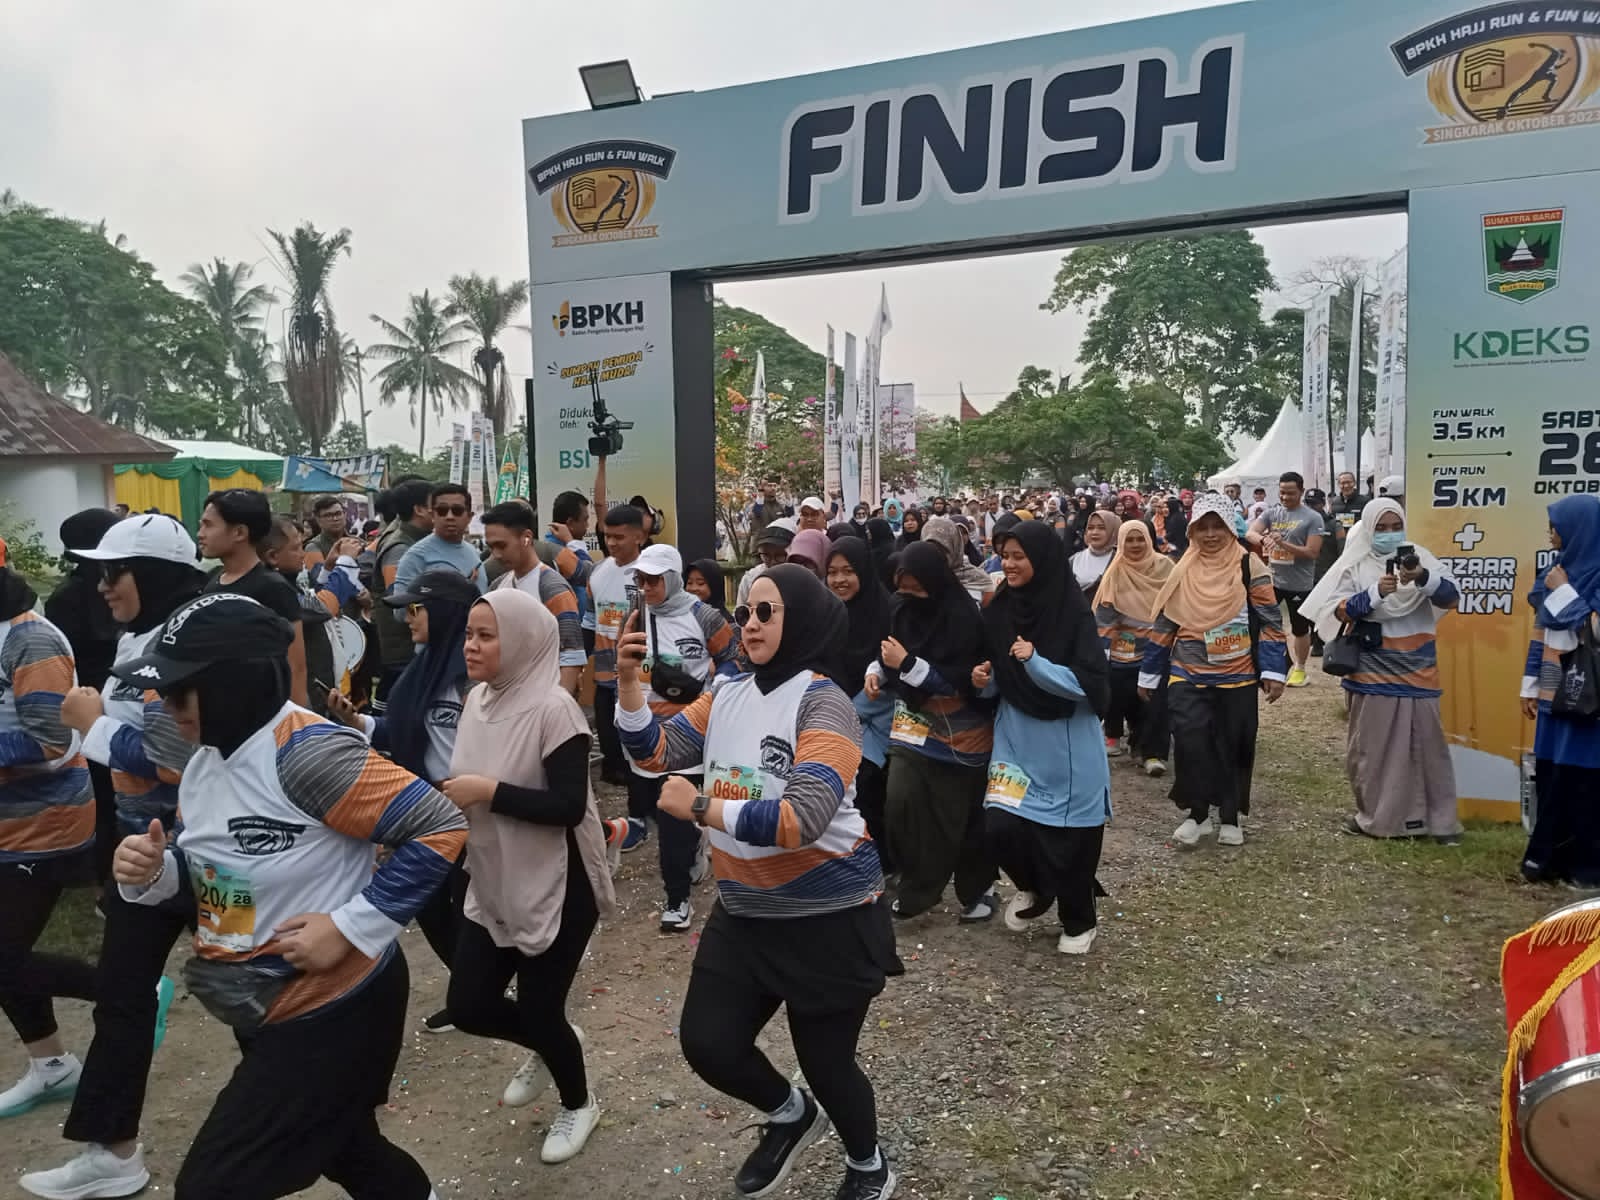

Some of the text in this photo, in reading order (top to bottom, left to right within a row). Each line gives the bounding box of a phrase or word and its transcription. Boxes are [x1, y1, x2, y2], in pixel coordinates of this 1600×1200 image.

[1405, 33, 1447, 60] BPKH
[1450, 20, 1485, 41] HAJJ
[1490, 12, 1524, 30] RUN
[1528, 11, 1540, 23] &
[1545, 10, 1578, 22] FUN
[785, 44, 1236, 218] FINISH
[1433, 119, 1504, 141] SINGKARAK
[1508, 113, 1565, 132] OKTOBER
[536, 150, 666, 182] BPKH HAJJ RUN & FUN WALK
[1532, 211, 1561, 221] BARAT
[571, 301, 644, 329] BPKH
[1454, 325, 1590, 360] KDEKS
[602, 351, 643, 369] PEMUDA
[600, 364, 637, 382] MUDA!
[560, 408, 595, 418] Diduku
[1433, 408, 1495, 418] FUN WALK
[1433, 422, 1505, 441] 3,5 KM
[560, 449, 590, 469] BSI
[1433, 466, 1485, 475] FUN RUN
[1433, 479, 1506, 507] 5 KM
[1535, 481, 1600, 494] OKTOB
[1440, 558, 1516, 576] AZAAR
[751, 788, 762, 798] 28
[233, 895, 251, 904] 28
